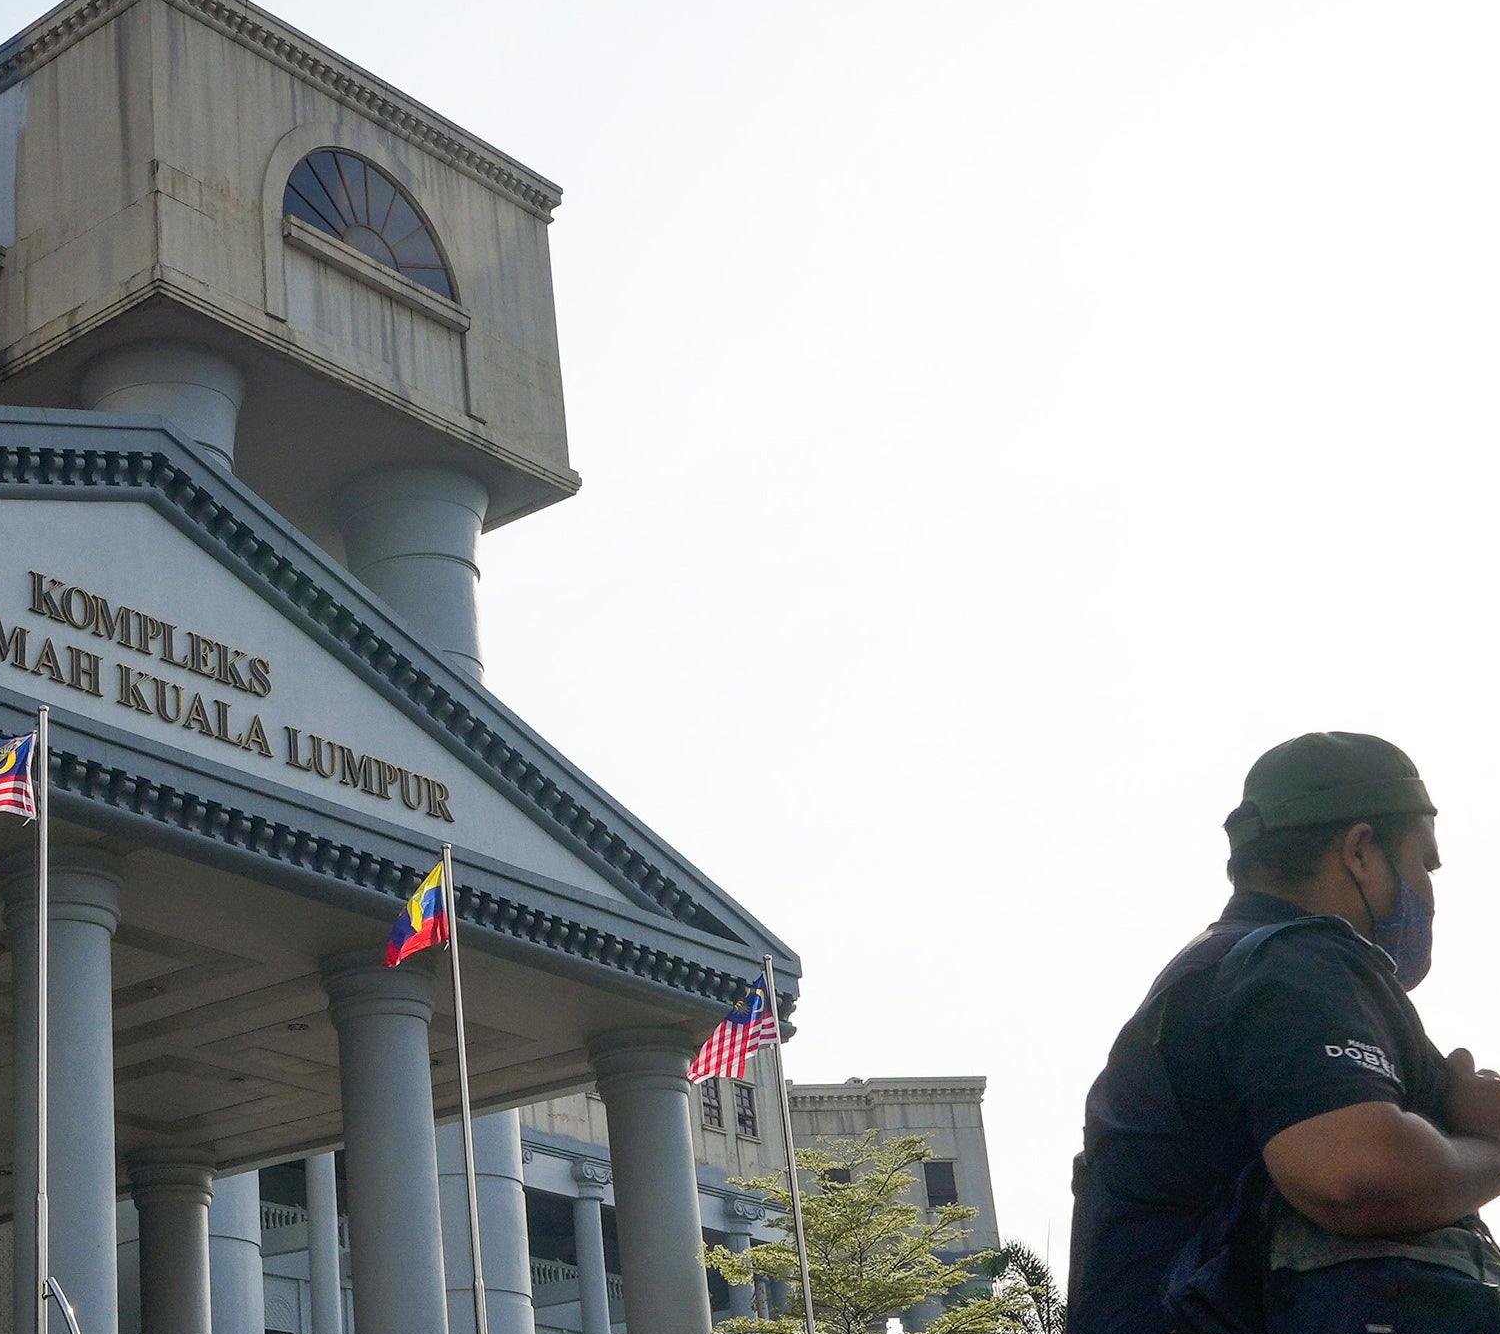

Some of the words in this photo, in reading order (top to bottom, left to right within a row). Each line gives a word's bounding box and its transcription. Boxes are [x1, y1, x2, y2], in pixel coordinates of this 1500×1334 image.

[29, 570, 272, 698] KOMPLEKS
[116, 663, 275, 758] KUALA
[284, 724, 456, 823] LUMPUR
